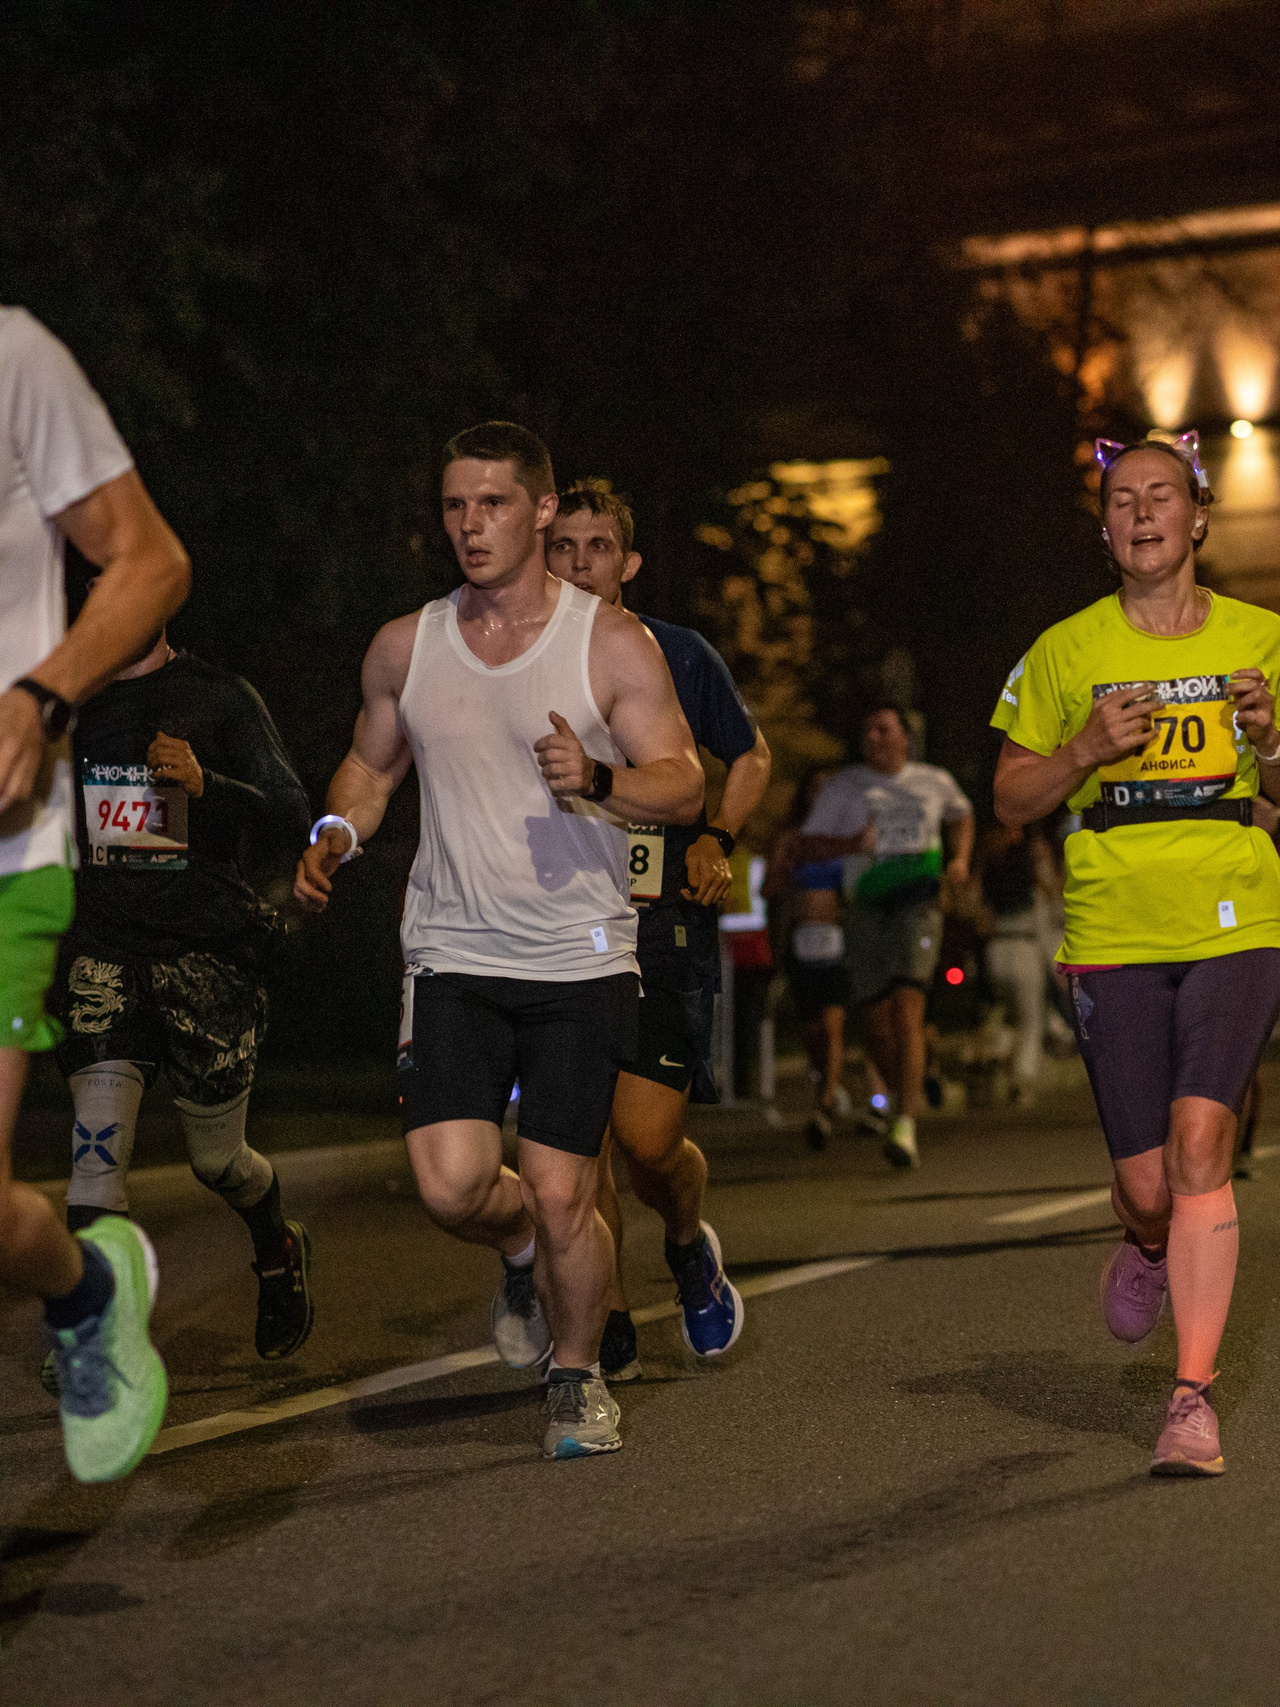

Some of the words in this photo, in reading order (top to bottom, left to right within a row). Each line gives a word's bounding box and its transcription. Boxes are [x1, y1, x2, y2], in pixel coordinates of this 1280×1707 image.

[1134, 714, 1206, 757] 70
[1140, 758, 1196, 772] АНФИСА
[1114, 786, 1130, 806] D
[98, 799, 169, 833] 9471
[629, 844, 649, 875] 8
